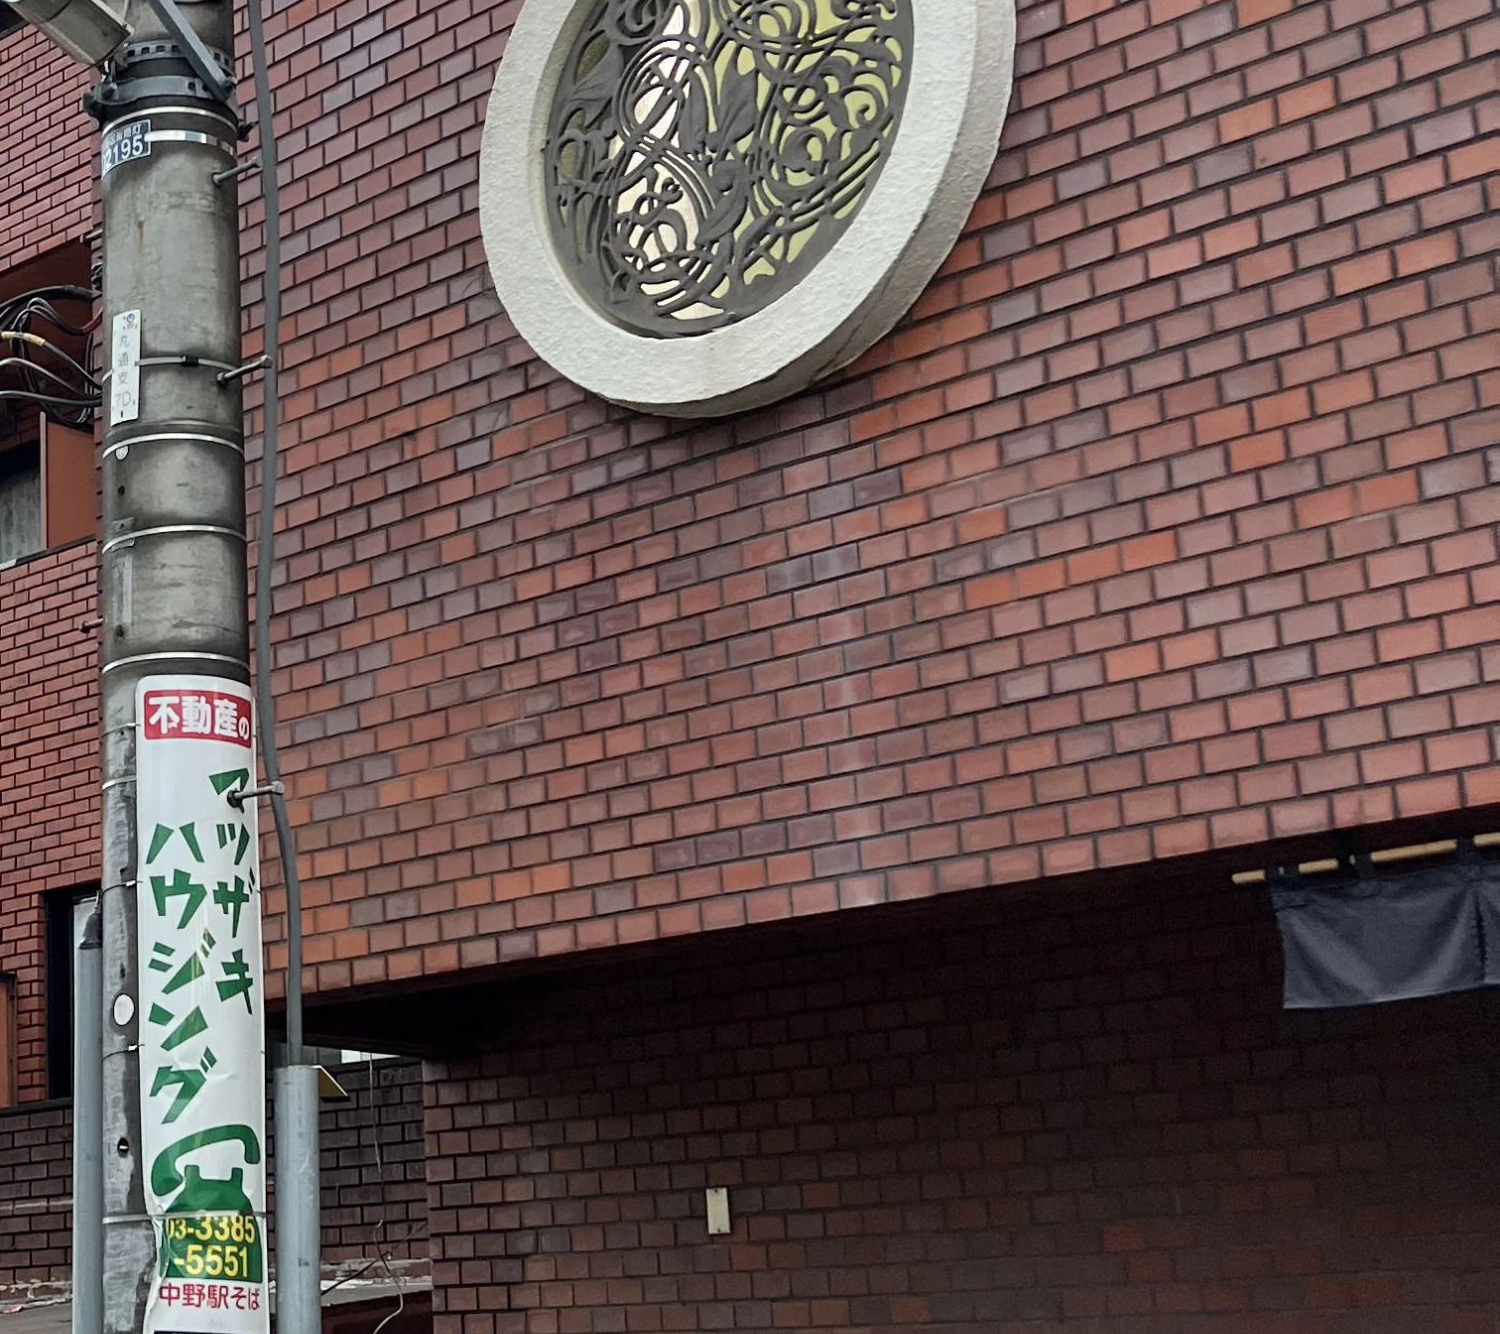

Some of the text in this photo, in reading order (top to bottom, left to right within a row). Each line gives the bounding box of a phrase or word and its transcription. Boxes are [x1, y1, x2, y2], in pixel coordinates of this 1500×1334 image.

[149, 695, 249, 741] 不動産の
[208, 767, 255, 1015] マツザキ
[145, 821, 217, 1124] ハウジング
[159, 1282, 260, 1310] 中野駅そば
